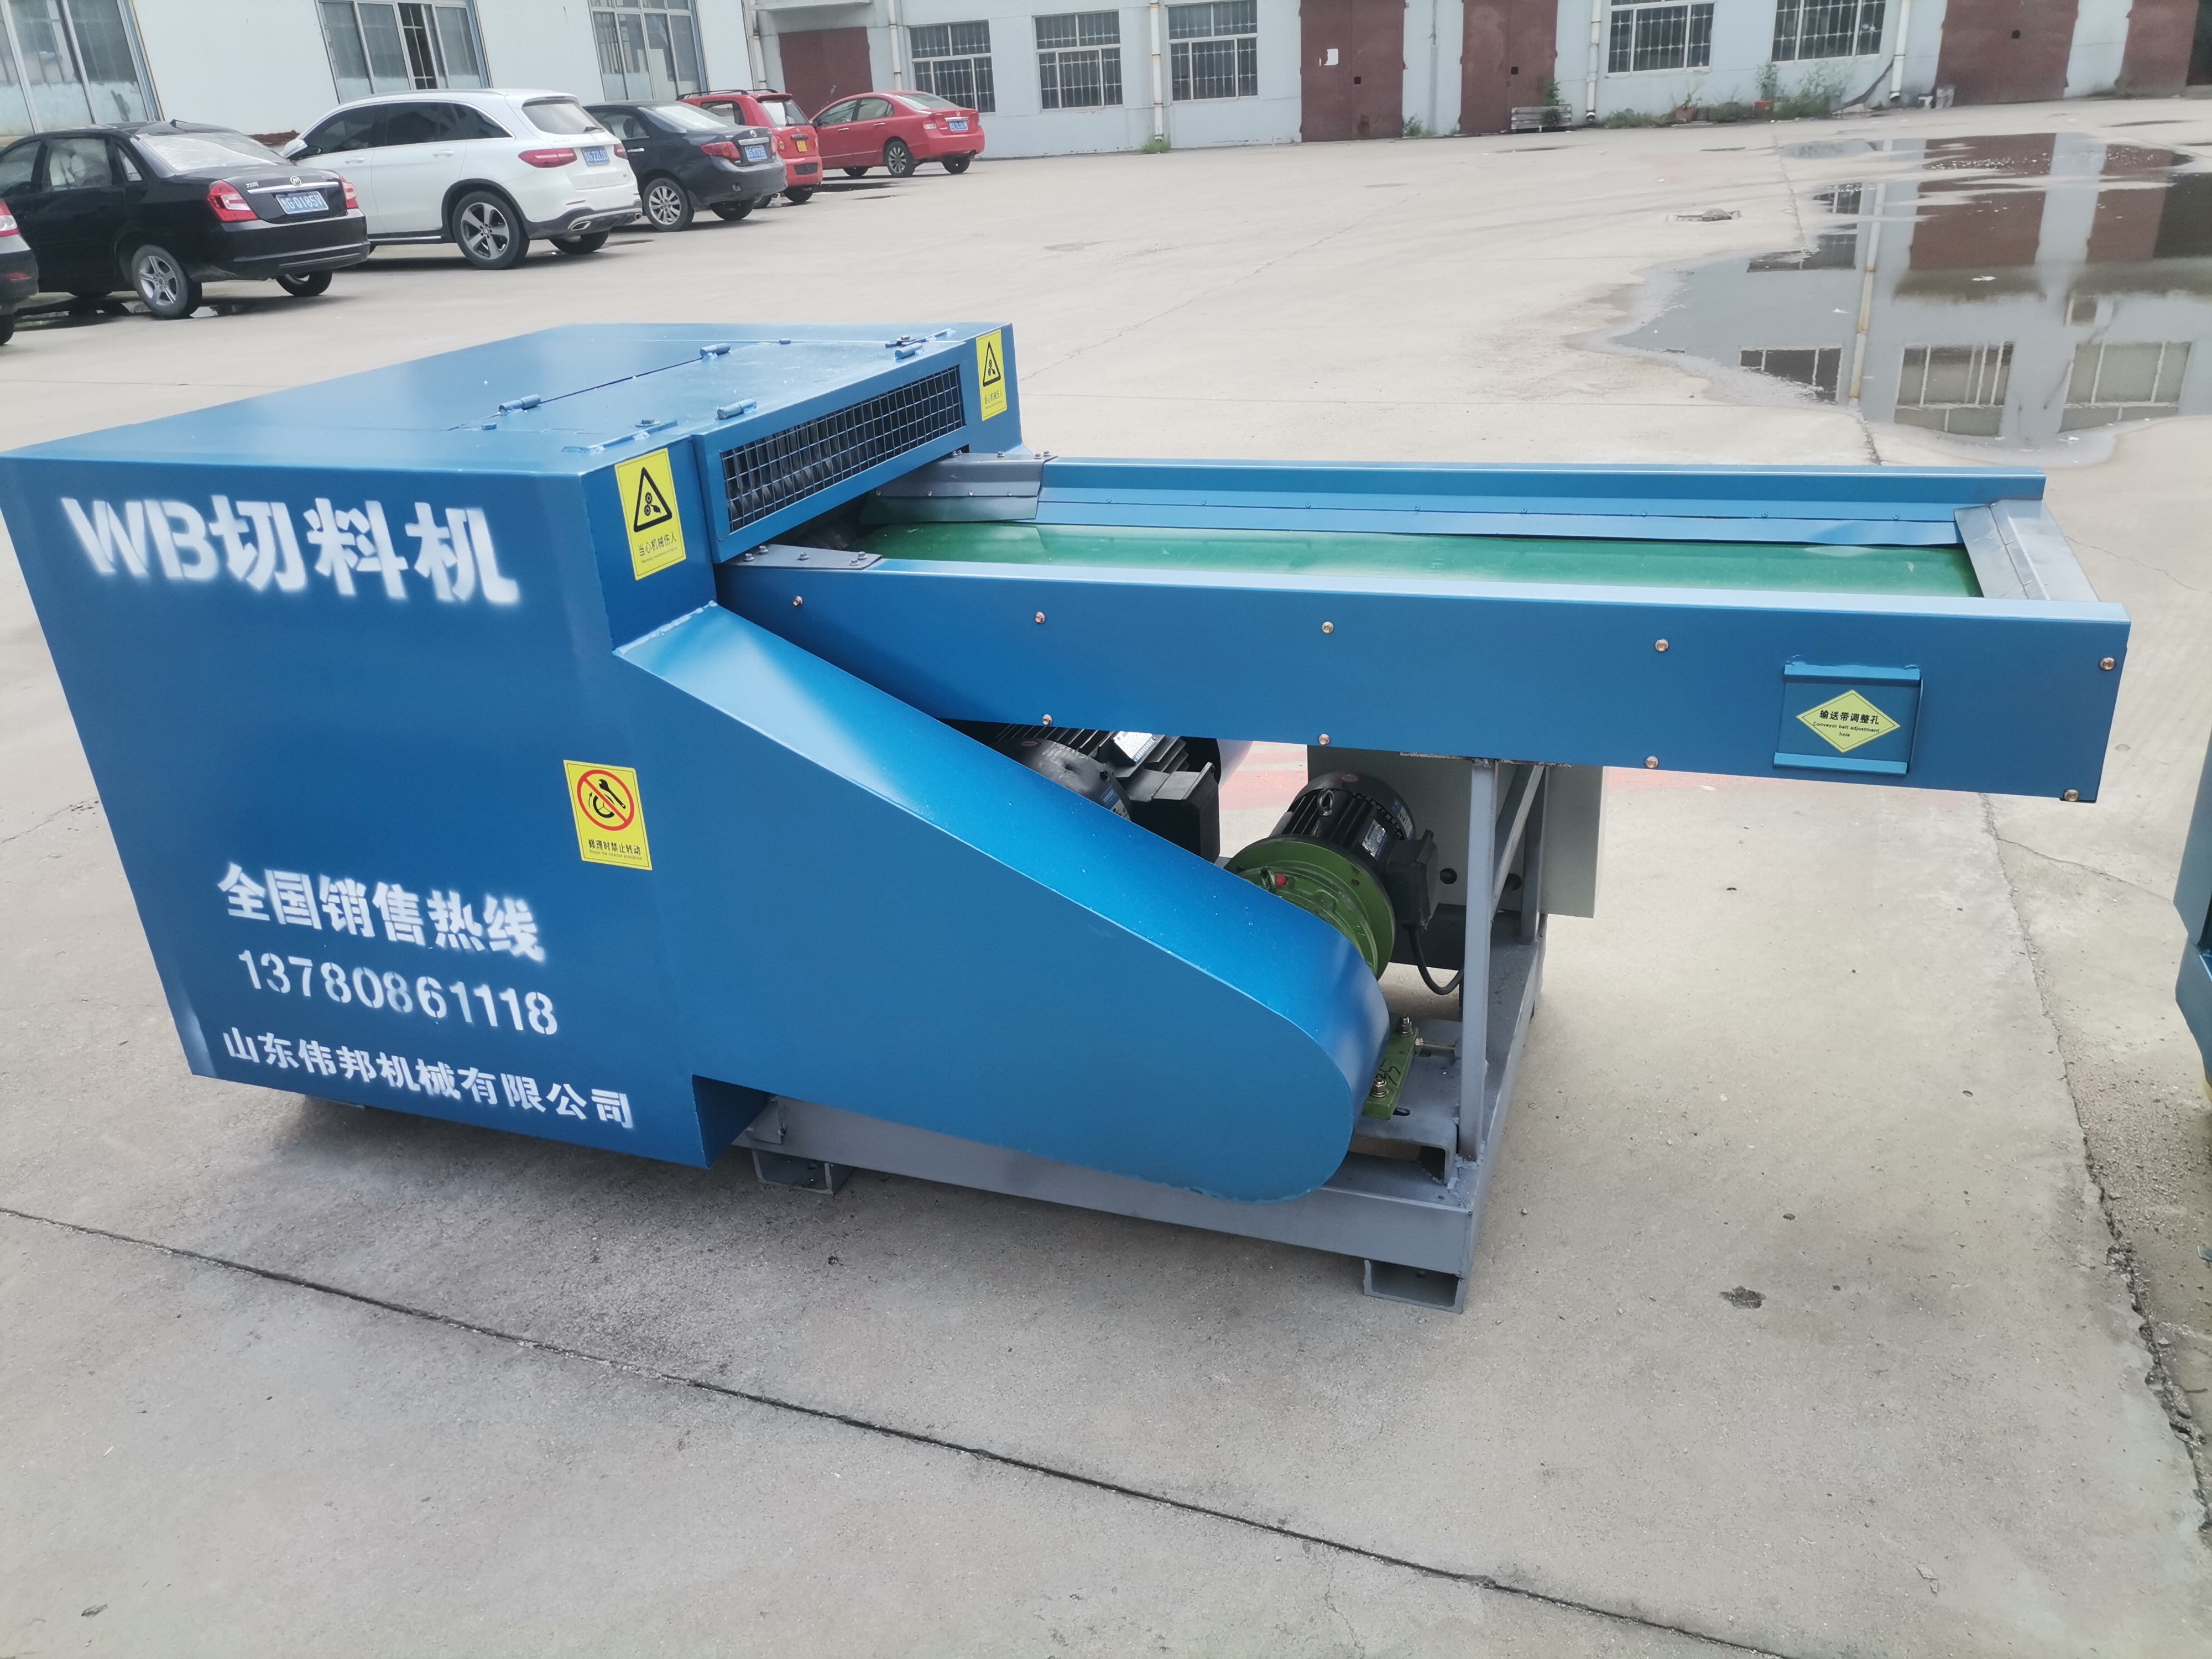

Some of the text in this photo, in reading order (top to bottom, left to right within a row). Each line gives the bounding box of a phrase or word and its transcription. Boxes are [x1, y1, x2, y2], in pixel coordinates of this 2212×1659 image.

[60, 494, 520, 607] WB切料机
[638, 530, 677, 557] 当心机械伤人
[1819, 709, 1879, 725] 输送带调整孔
[588, 838, 641, 855] 修理时禁止转动
[217, 863, 546, 963] 全国销售热线
[238, 949, 558, 1036] 13780861118
[222, 1026, 633, 1129] 山东伟邦机械有限公司
